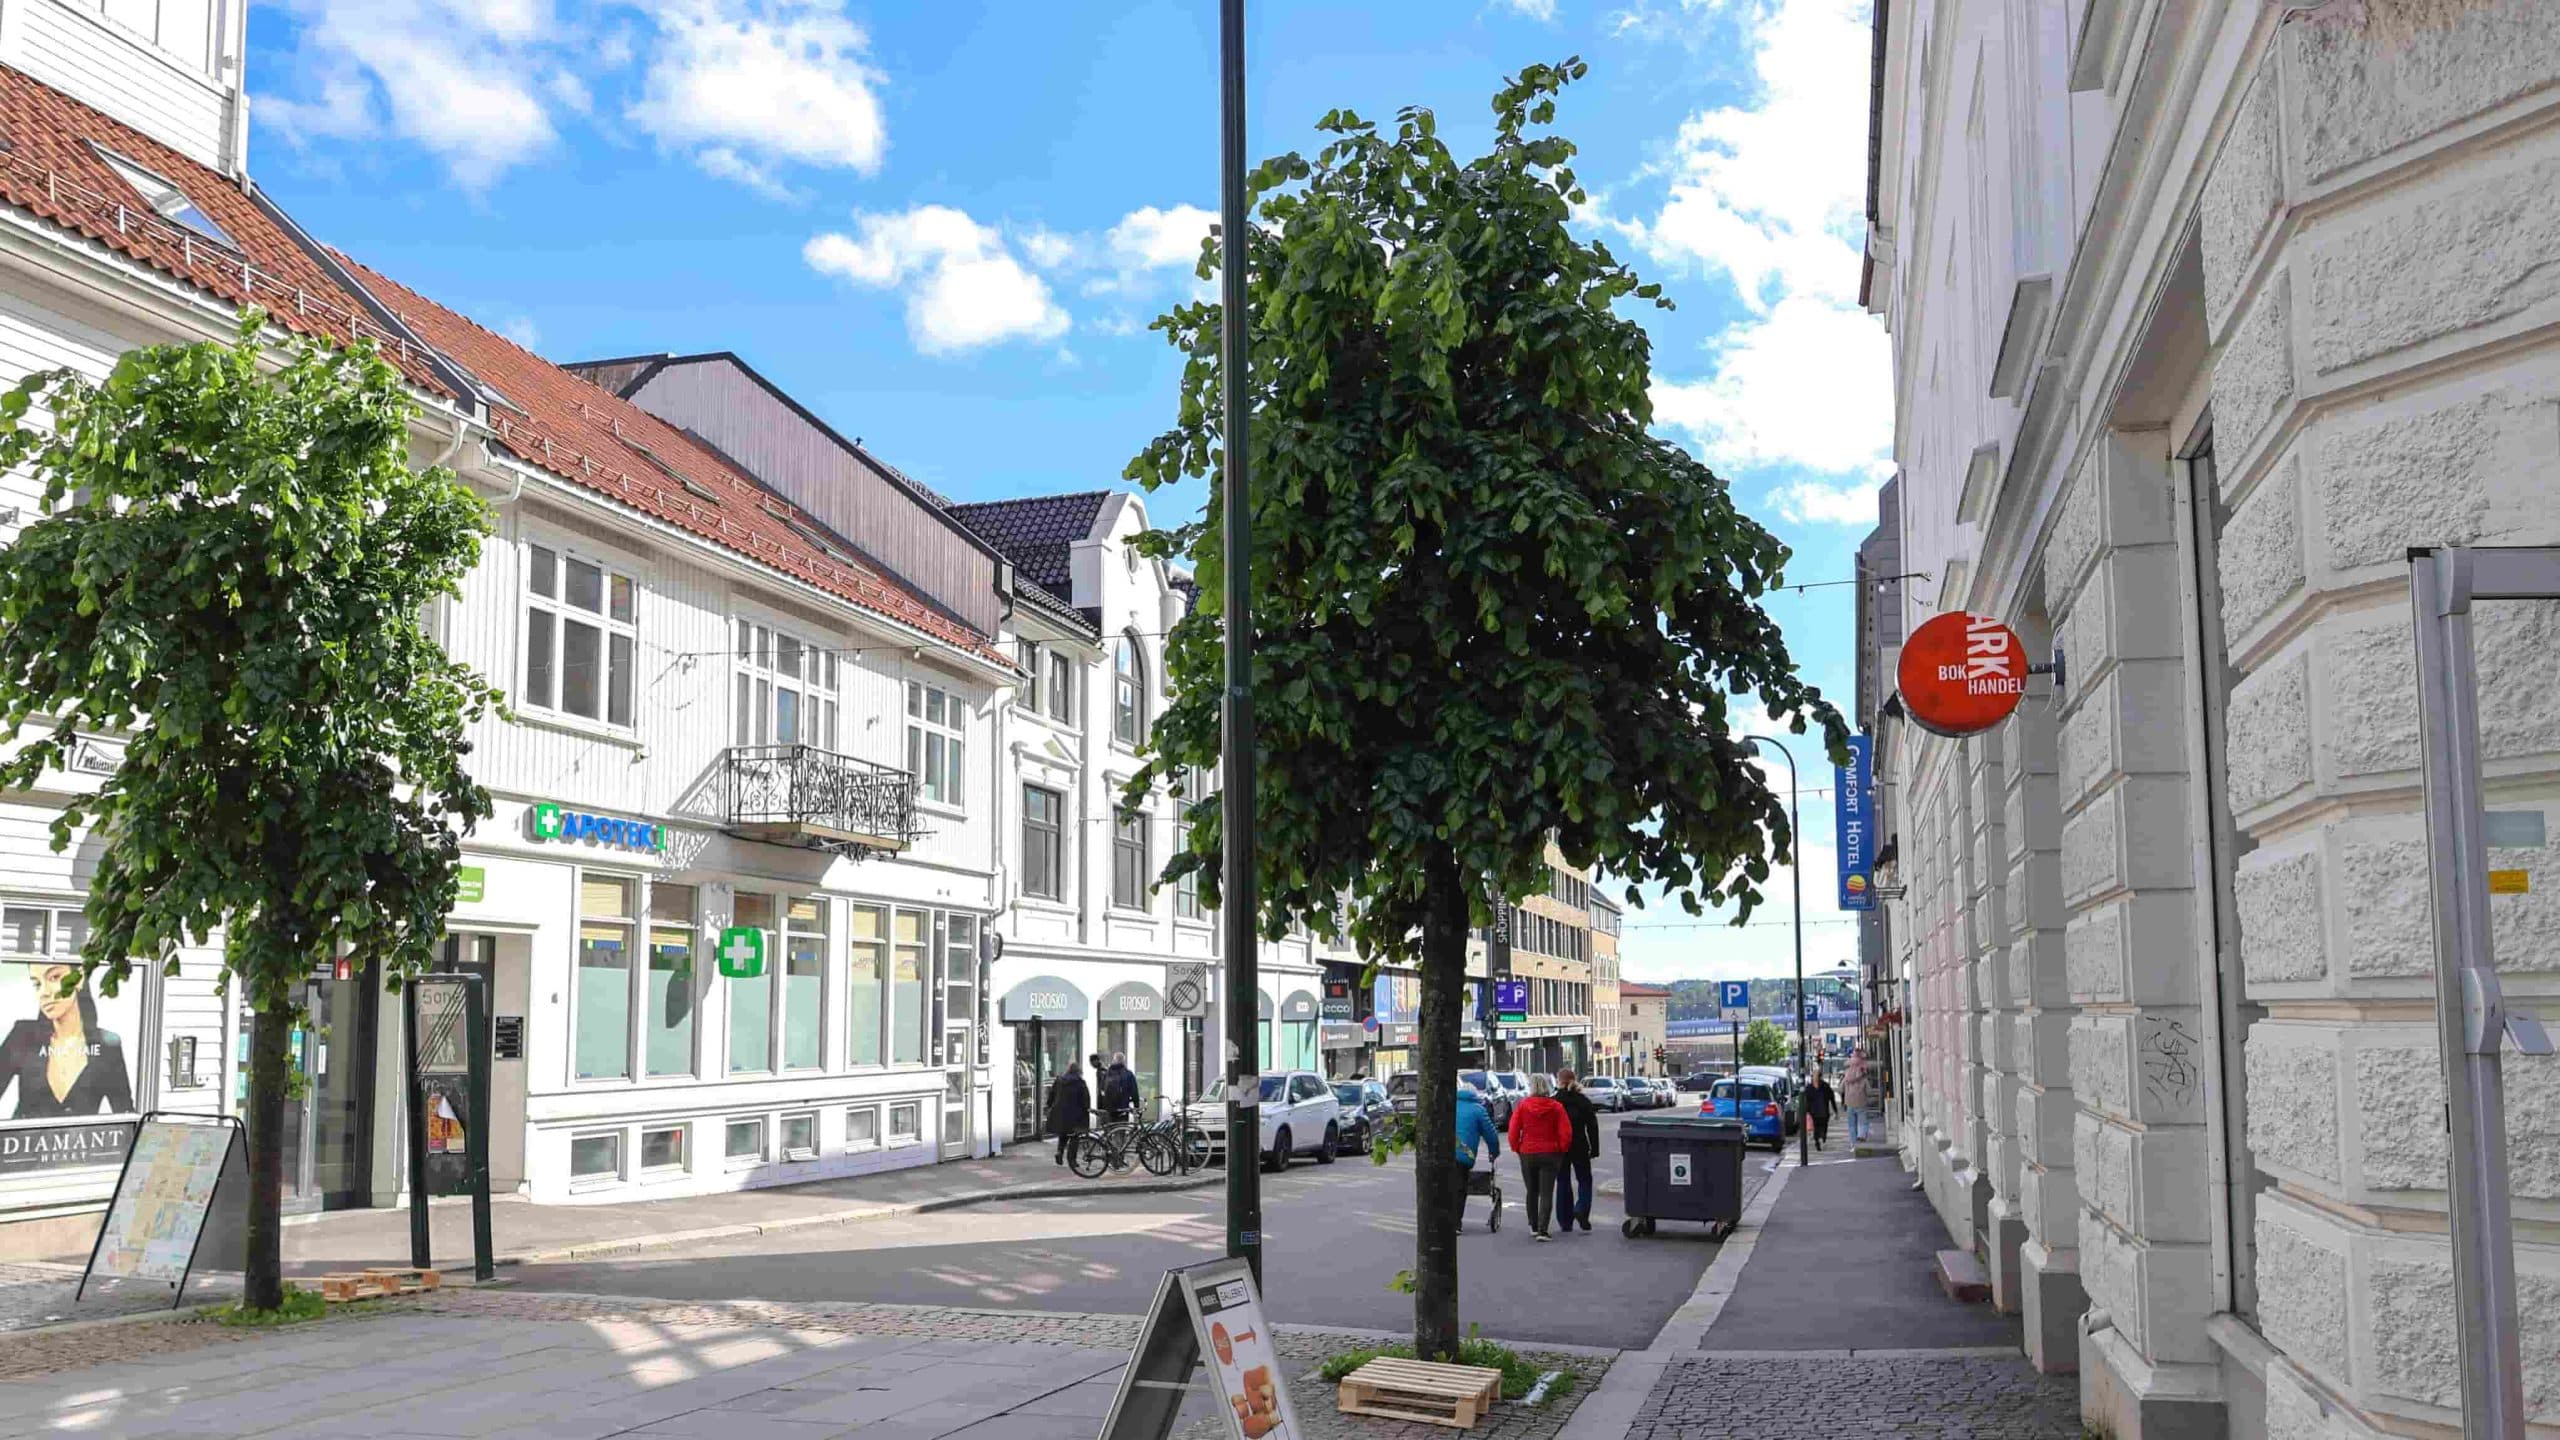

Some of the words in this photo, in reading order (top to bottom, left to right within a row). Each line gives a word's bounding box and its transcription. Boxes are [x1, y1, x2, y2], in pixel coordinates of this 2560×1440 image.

[1966, 611, 2010, 680] ARK
[1938, 664, 1968, 681] BOK
[1968, 678, 2025, 696] HANDEL
[1845, 744, 1860, 814] COMFORT
[562, 812, 655, 849] APOTEK
[1846, 821, 1862, 869] HOTEL
[1029, 991, 1068, 1010] EUROSKO
[1119, 995, 1151, 1012] EUROSKO
[1514, 989, 1526, 1004] P
[1726, 984, 1742, 1005] P
[1324, 1004, 1351, 1014] ecco
[1804, 1006, 1814, 1019] P
[3, 1129, 124, 1155] DIAMANT
